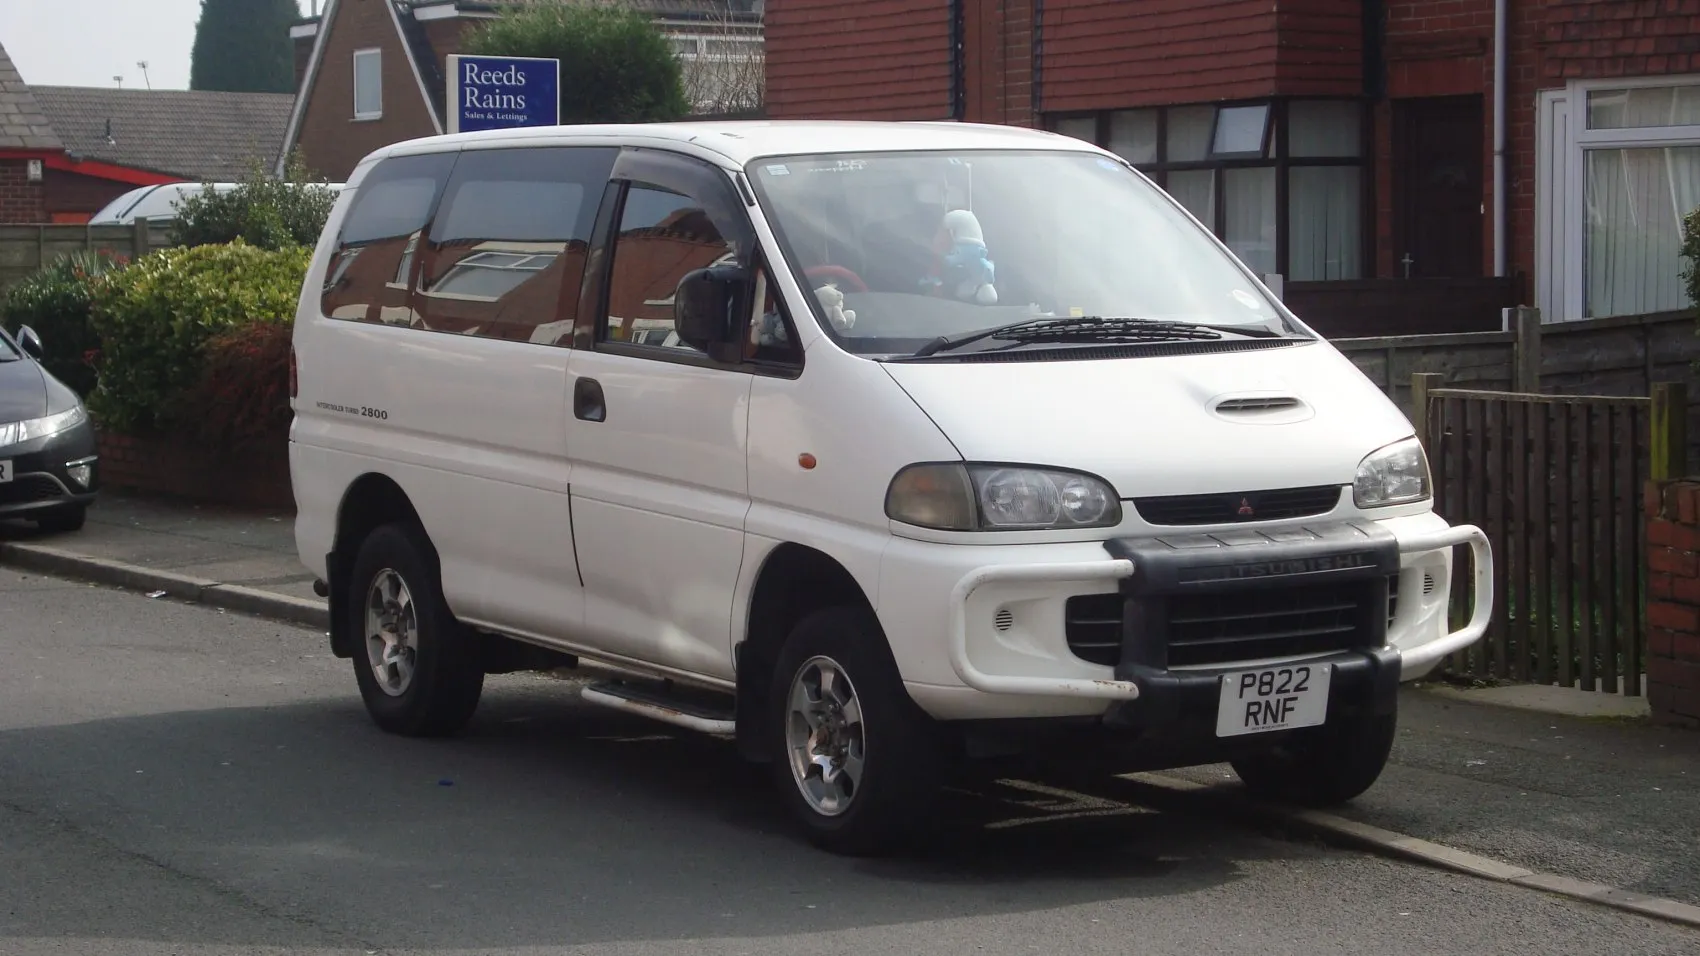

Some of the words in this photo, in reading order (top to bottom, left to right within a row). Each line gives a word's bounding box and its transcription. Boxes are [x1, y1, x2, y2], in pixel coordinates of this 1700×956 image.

[464, 63, 526, 86] Reeds
[464, 87, 526, 109] Rains
[465, 111, 485, 119] Sales
[496, 113, 528, 122] Lettings
[361, 406, 388, 420] 2800
[1200, 554, 1364, 579] ITSUBISHI
[1239, 667, 1311, 699] P822
[1244, 697, 1298, 727] RNF
